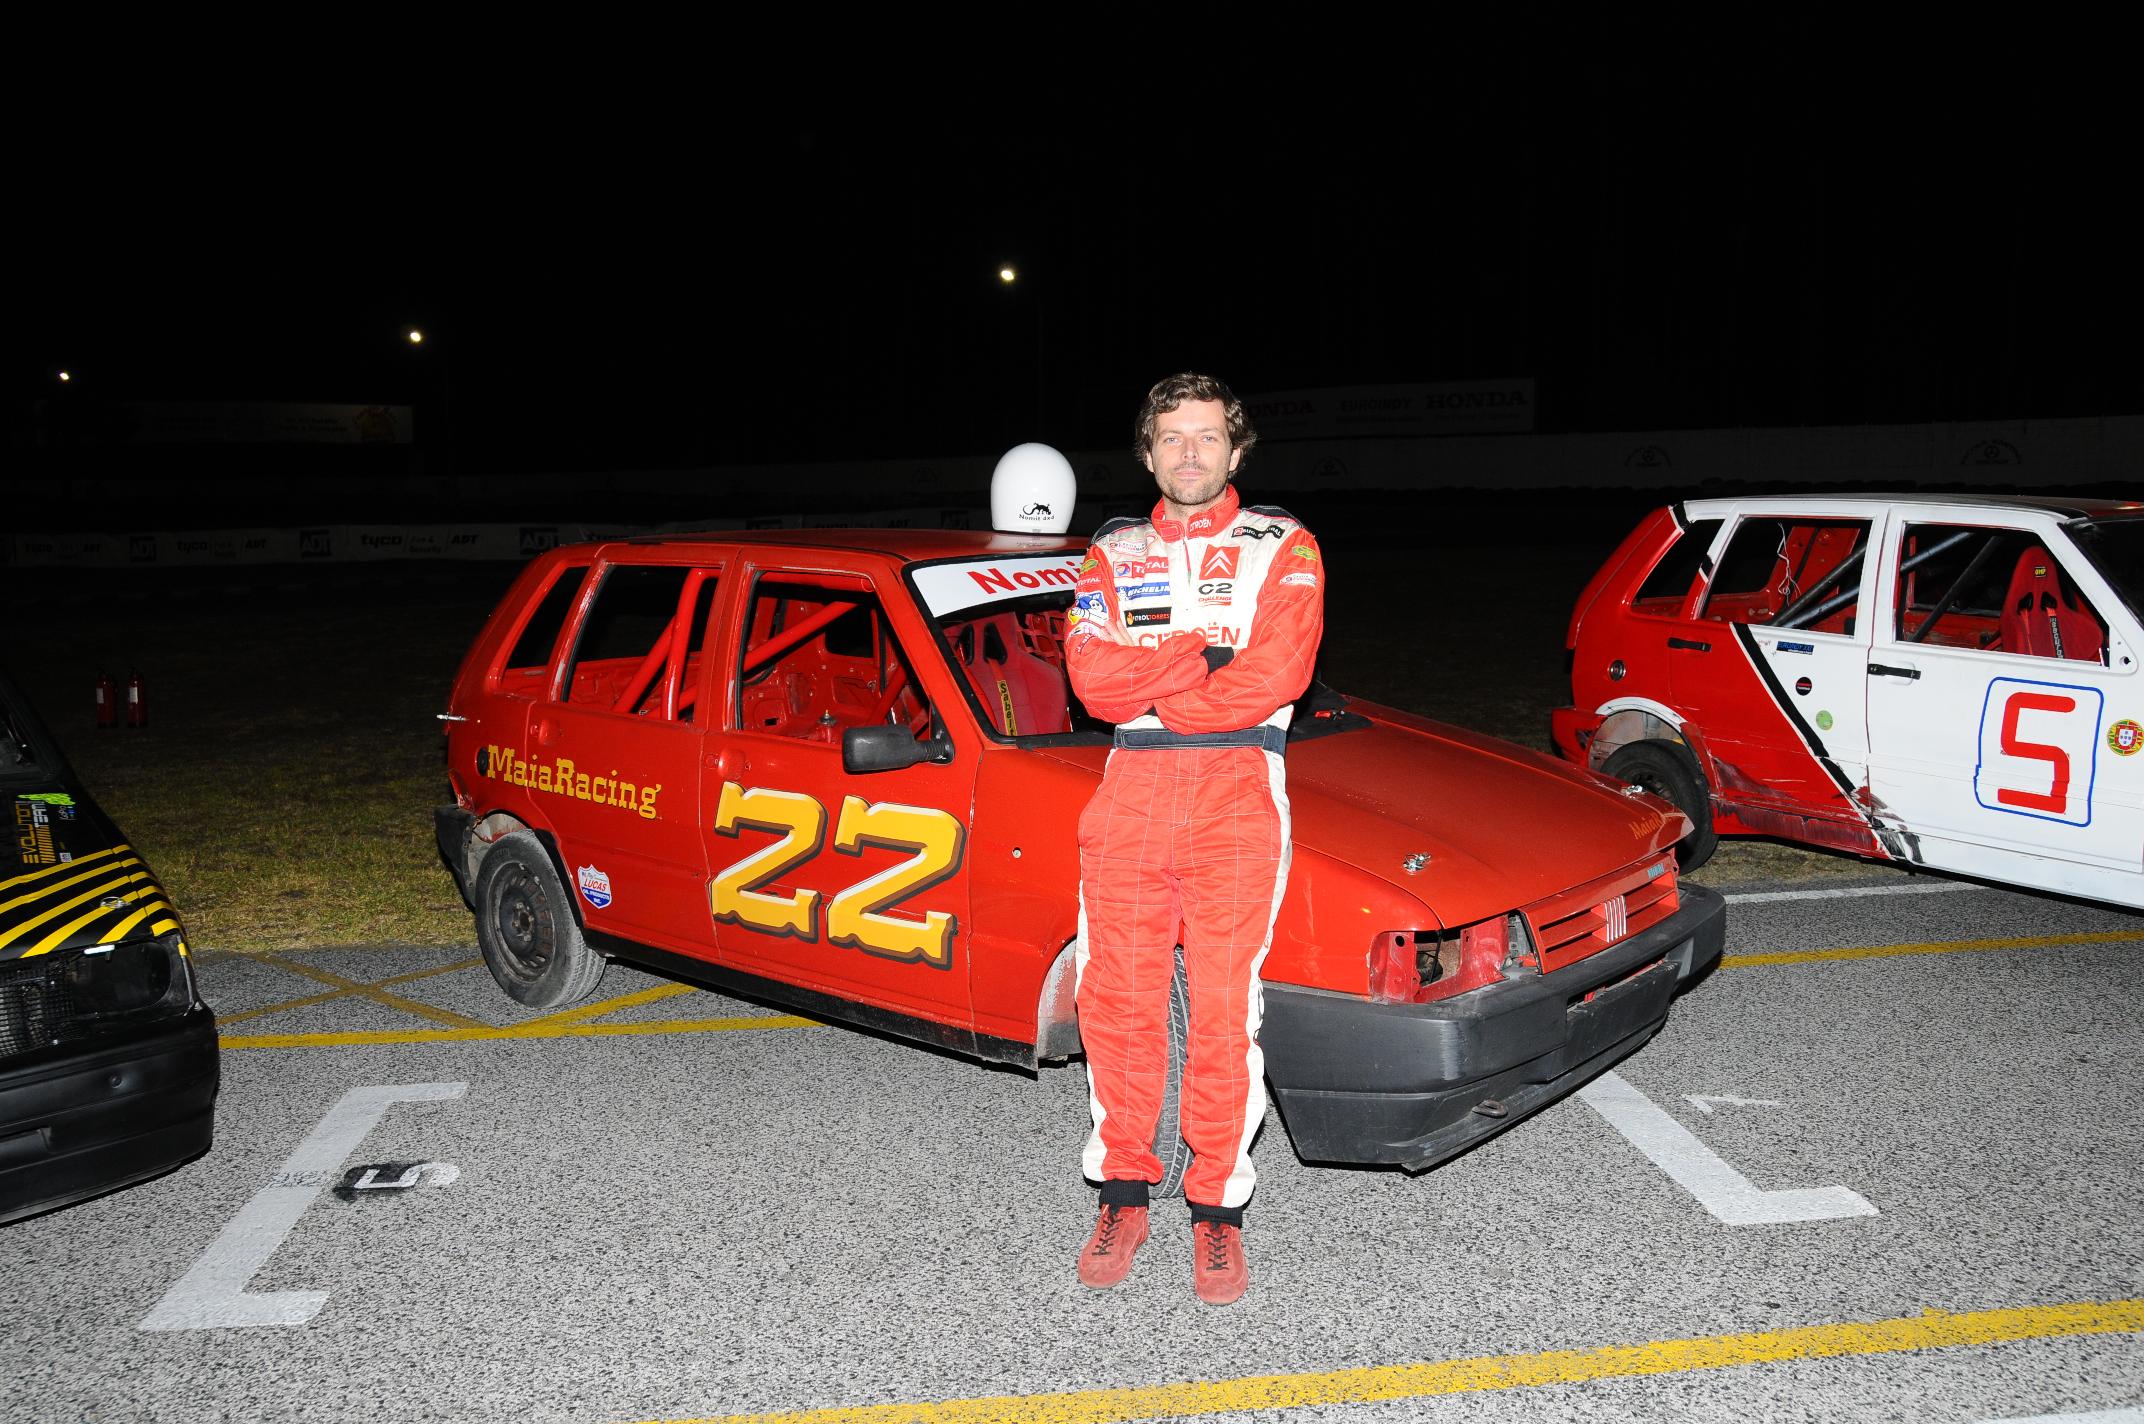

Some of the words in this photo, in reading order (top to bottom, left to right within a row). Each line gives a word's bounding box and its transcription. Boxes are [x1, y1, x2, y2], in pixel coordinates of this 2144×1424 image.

[1424, 390, 1528, 409] HONDA
[1247, 400, 1317, 416] ONDA
[360, 534, 402, 548] tyco
[450, 534, 480, 545] ADT
[1198, 582, 1232, 595] C2
[1997, 691, 2076, 815] 5
[486, 744, 662, 820] MaiaRacing
[710, 780, 967, 970] 22
[584, 878, 607, 892] LUCAS
